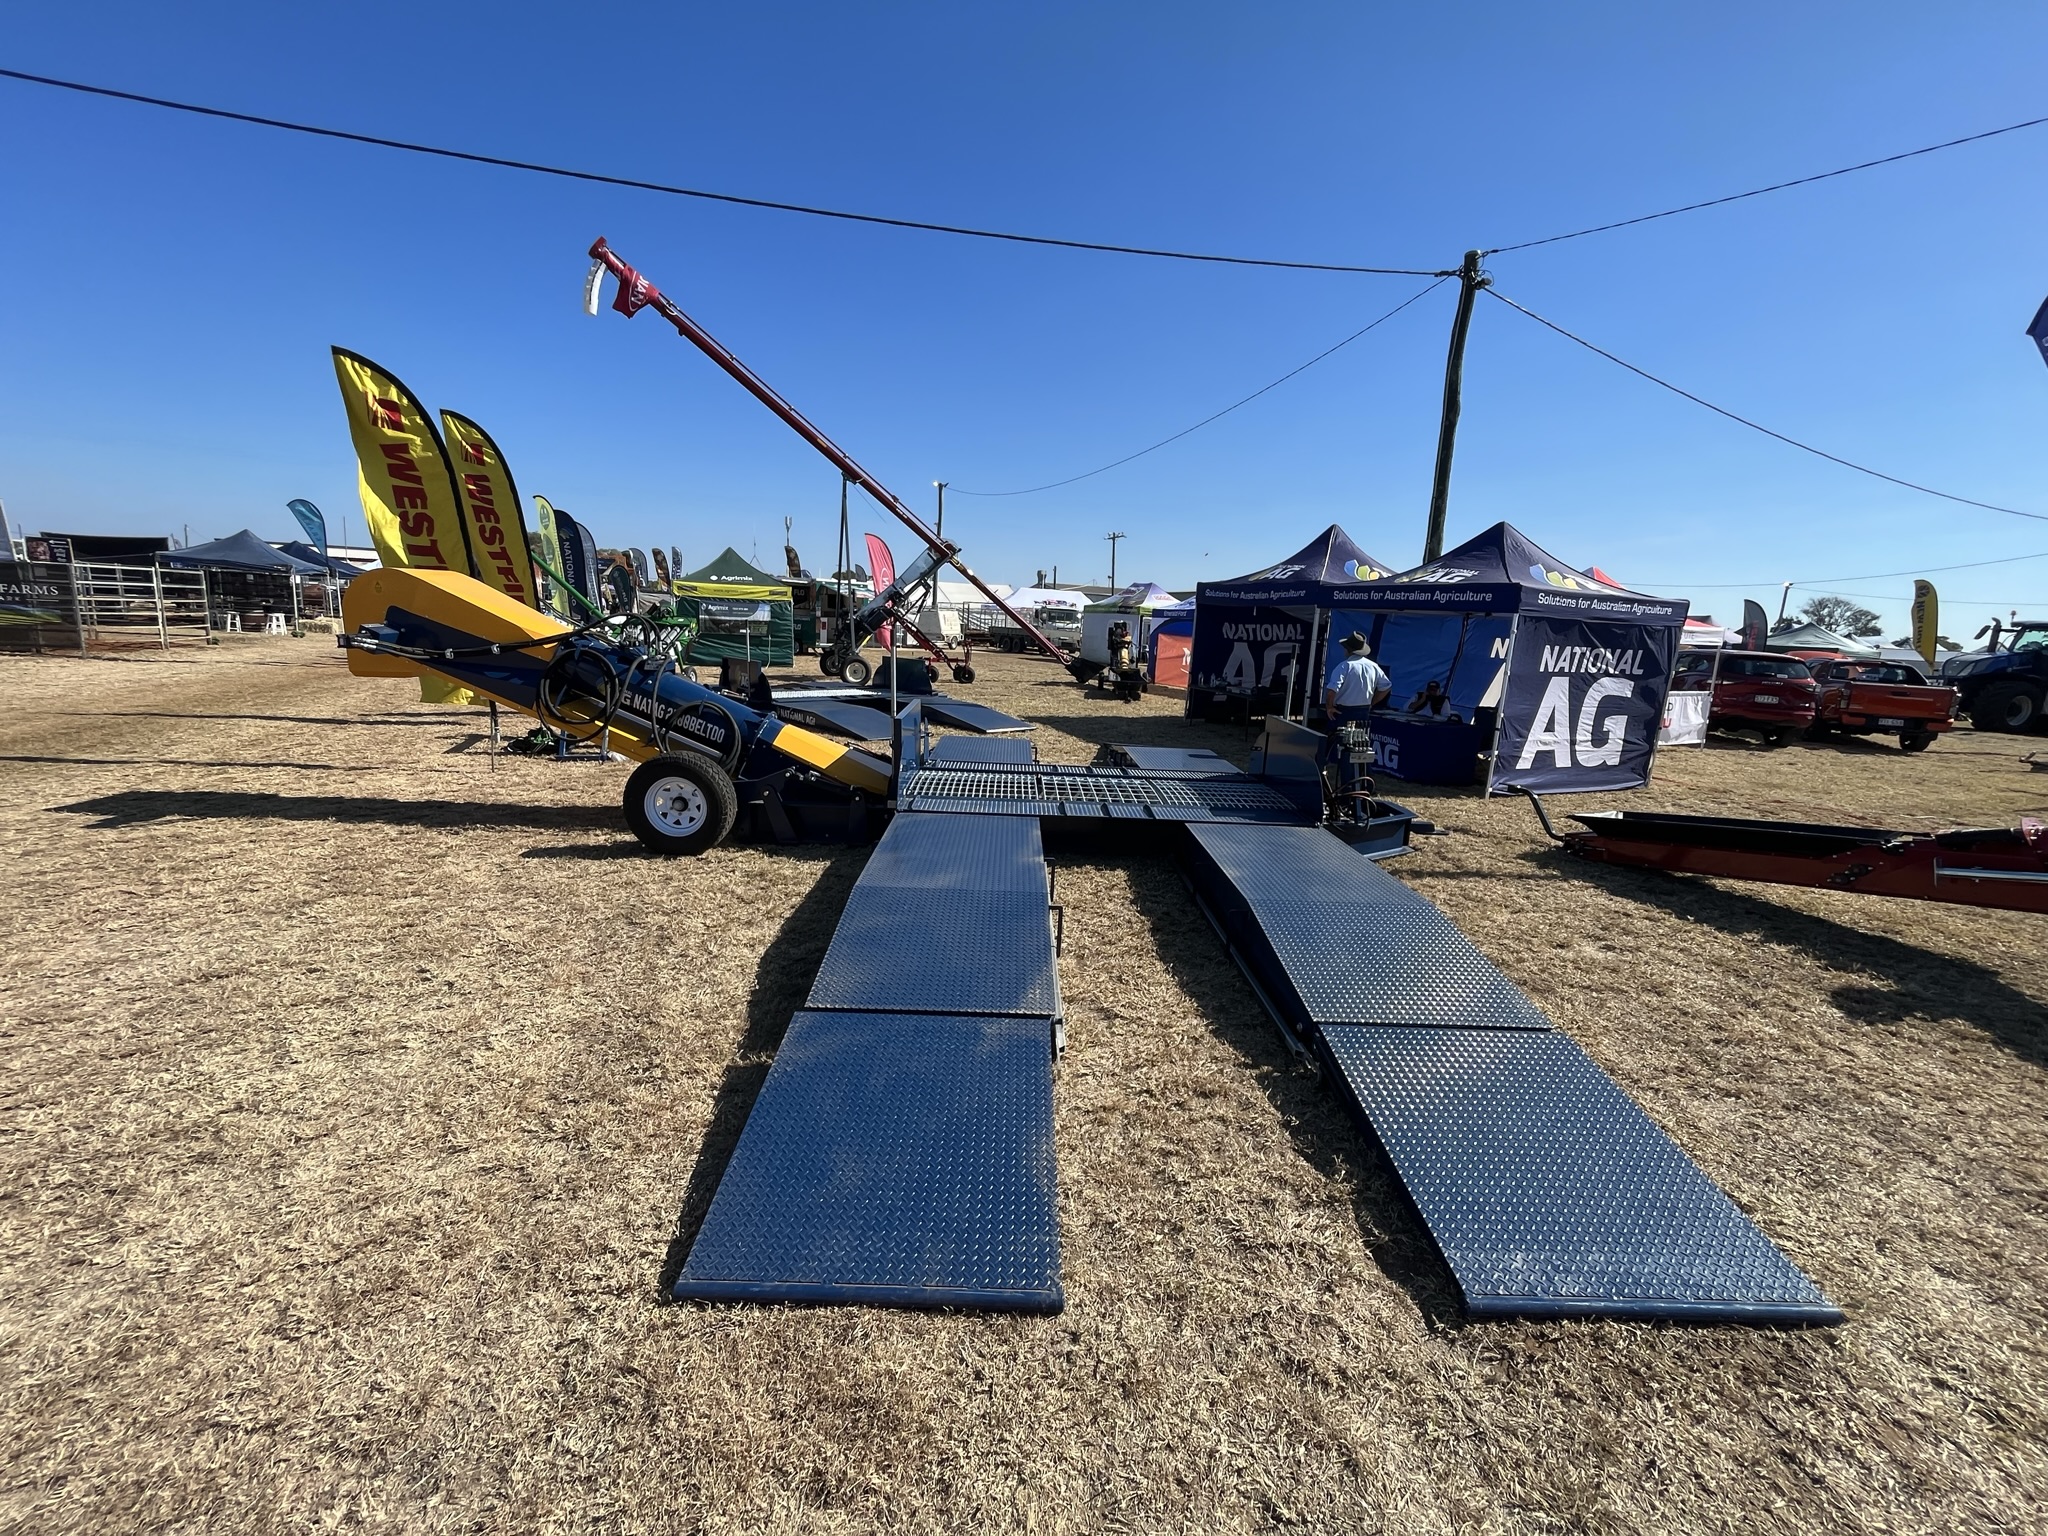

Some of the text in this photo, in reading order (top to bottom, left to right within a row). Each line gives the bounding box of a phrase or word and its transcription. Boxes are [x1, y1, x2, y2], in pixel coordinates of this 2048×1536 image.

[379, 443, 448, 571] WEST
[1413, 571, 1473, 583] AG
[0, 583, 59, 596] FARMS
[1205, 589, 1306, 600] Solutions for Australian Agriculture
[1333, 590, 1493, 604] Solutions for Australian Agriculture
[1538, 592, 1673, 616] Solutions for Australian Agriculture
[707, 604, 729, 612] Agrimix
[1222, 622, 1305, 641] NATIONAL
[1539, 645, 1644, 675] NATIONAL
[1515, 676, 1635, 770] AG
[1370, 733, 1400, 746] NATIONAL
